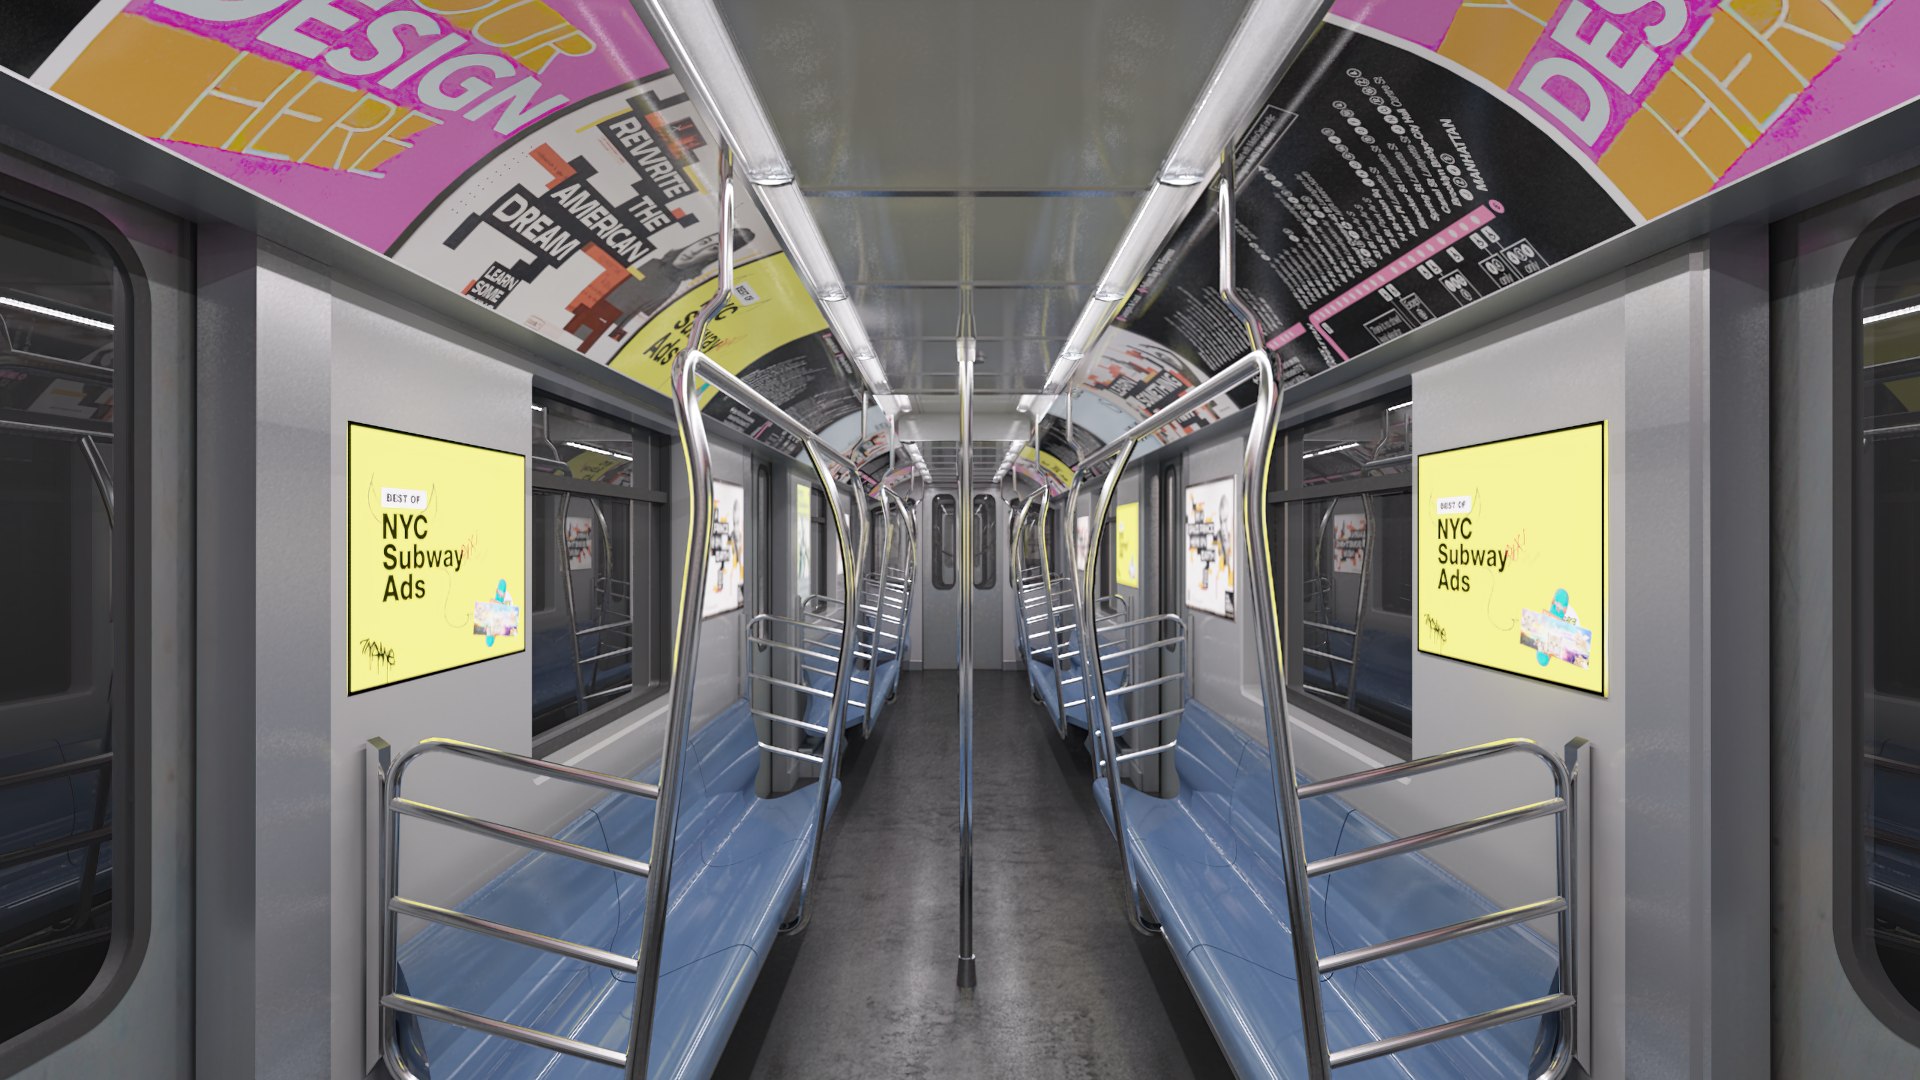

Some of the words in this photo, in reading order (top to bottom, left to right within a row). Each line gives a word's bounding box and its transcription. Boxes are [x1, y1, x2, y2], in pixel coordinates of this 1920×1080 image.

[411, 0, 597, 75] UR
[152, 0, 569, 136] ESIGN
[160, 50, 445, 179] HERE
[609, 116, 691, 199] REWRITE
[1440, 118, 1489, 192] MANHATTAN
[492, 193, 581, 261] DREAM
[551, 183, 650, 268] AMERICAN
[628, 194, 672, 232] THE
[471, 280, 505, 303] SOME
[484, 265, 519, 291] LEARN
[643, 332, 679, 365] Ads
[386, 492, 408, 504] BEST
[410, 494, 421, 504] OF
[382, 513, 428, 540] NYC
[1437, 517, 1473, 540] NYC
[382, 543, 464, 572] Subway
[1438, 543, 1508, 573] Subway
[382, 573, 426, 602] Ads
[1438, 568, 1471, 592] Ads
